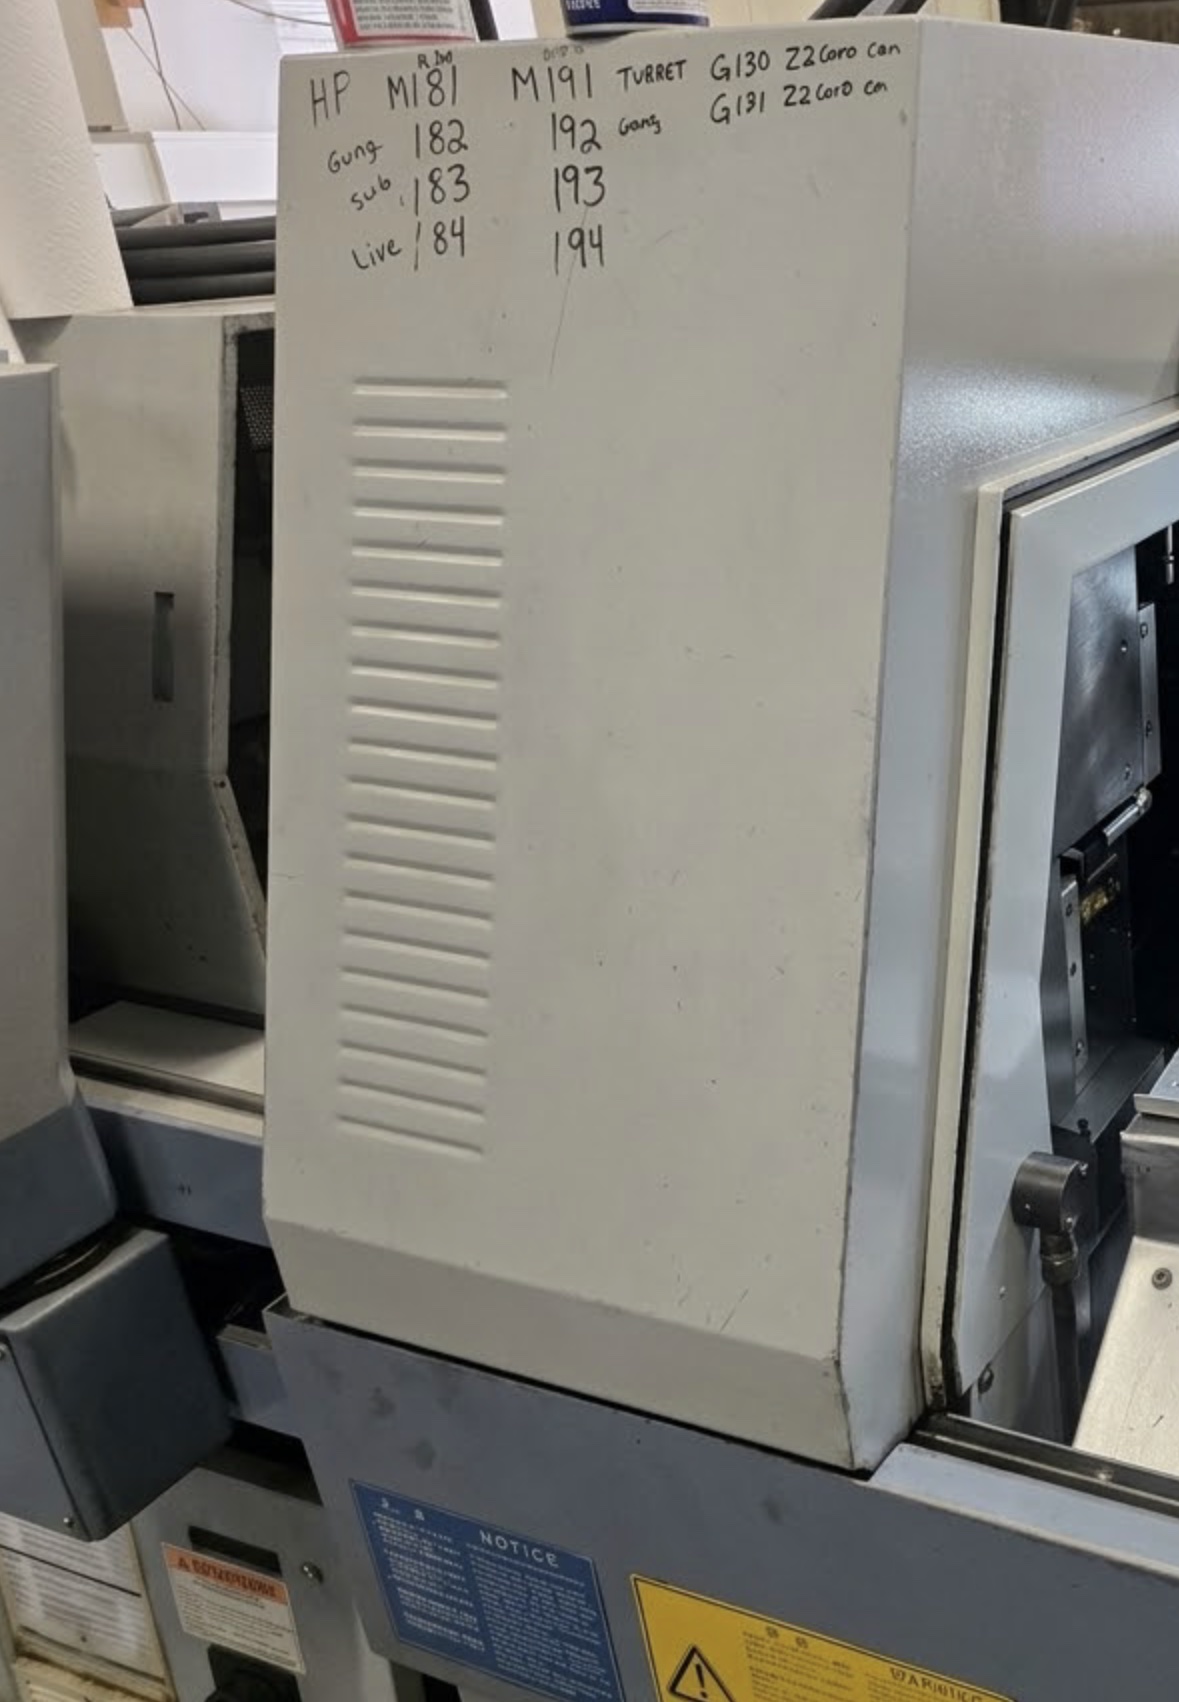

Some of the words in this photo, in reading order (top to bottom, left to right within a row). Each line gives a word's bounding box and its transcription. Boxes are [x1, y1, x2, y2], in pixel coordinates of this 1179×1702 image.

[310, 70, 351, 127] HP
[387, 65, 457, 110] M181
[512, 62, 592, 102] M191
[616, 59, 687, 91] TURRET
[710, 50, 770, 81] G130
[710, 91, 765, 124] G131
[415, 119, 468, 159] 182
[552, 112, 602, 154] 192
[414, 163, 470, 216] 183
[554, 164, 605, 213] 193
[414, 215, 465, 271] 184
[555, 224, 604, 276] 194
[479, 1529, 560, 1568] NOTICE
